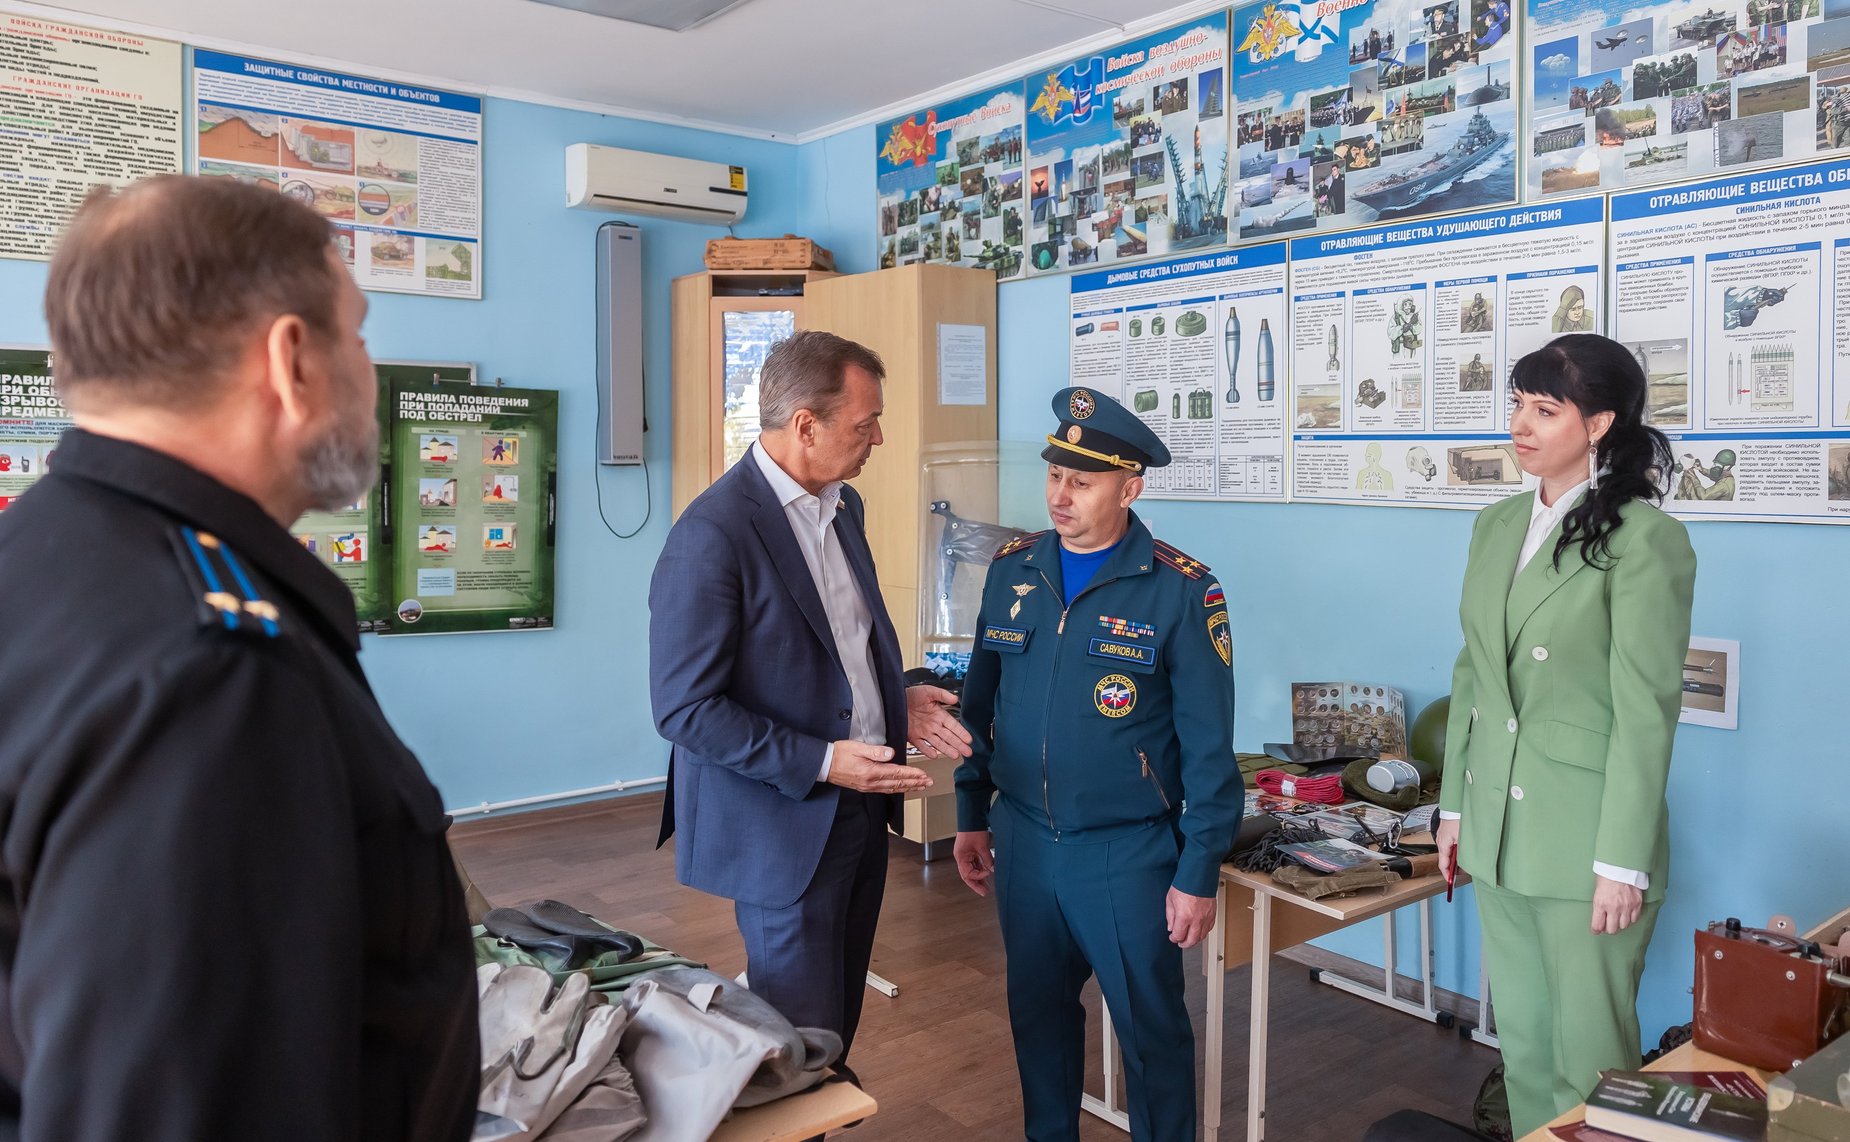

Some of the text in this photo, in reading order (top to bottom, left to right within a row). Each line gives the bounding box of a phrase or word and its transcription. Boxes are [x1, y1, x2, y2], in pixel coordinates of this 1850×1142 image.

[10, 18, 42, 28] ВОЙСКА
[46, 23, 104, 38] ГРАЖДАНСКОЙ
[108, 34, 144, 46] ОБОРОНЫ
[1107, 32, 1208, 72] Войска воздушно-
[1095, 48, 1222, 94] космической обороны
[13, 76, 72, 90] ГРАЖДАНСКИЕ
[76, 86, 130, 98] ОРГАНИЗАЦИИ
[244, 63, 440, 103] ЗАЩИТНЫЕ СВОЙСТВА МЕСТНОСТИ И ОБЪЕКТОВ
[1650, 184, 1746, 208] ОТРАВЛЯЮЩИЕ
[1750, 172, 1822, 194] ВЕЩЕСТВА
[1736, 196, 1820, 214] СИНИЛЬНАЯ КИСЛОТА
[1321, 208, 1562, 251] ОТРАВЛЯЮЩИЕ ВЕЩЕСТВА УДУШАЮЩЕГО ДЕЙСТВИЯ
[1616, 229, 1654, 238] СИНИЛЬНАЯ
[1654, 225, 1683, 233] КИСЛОТА
[1738, 214, 1765, 223] жидкость
[1800, 208, 1826, 216] горького
[1630, 236, 1662, 244] зараженном
[1692, 226, 1736, 236] концентрацией
[1738, 220, 1779, 230] СИНИЛЬНОЙ
[1782, 216, 1816, 224] КИСЛОТЫ
[1646, 239, 1683, 249] СИНИЛЬНОЙ
[1685, 234, 1715, 243] КИСЛОТЫ
[1728, 229, 1765, 239] воздействии
[1728, 246, 1796, 258] СРЕДСТВА ОБНАРУЖЕНИЯ
[1107, 255, 1238, 284] ДЫМОВЫЕ СРЕДСТВА СУХОПУТНЫХ ВОЙСК
[1747, 260, 1780, 268] СИНИЛЬНОЙ
[400, 392, 528, 407] ПРАВИЛА ПОВЕДЕНИЯ
[400, 402, 500, 414] ПРИ ПОПАДАНИИ
[400, 410, 482, 422] ПОД ОБСТРЕЛ
[986, 629, 1024, 642] МЧС РОССИИ
[1097, 676, 1135, 692] МЧС РОССИИ
[1098, 704, 1133, 716] EMERCOM
